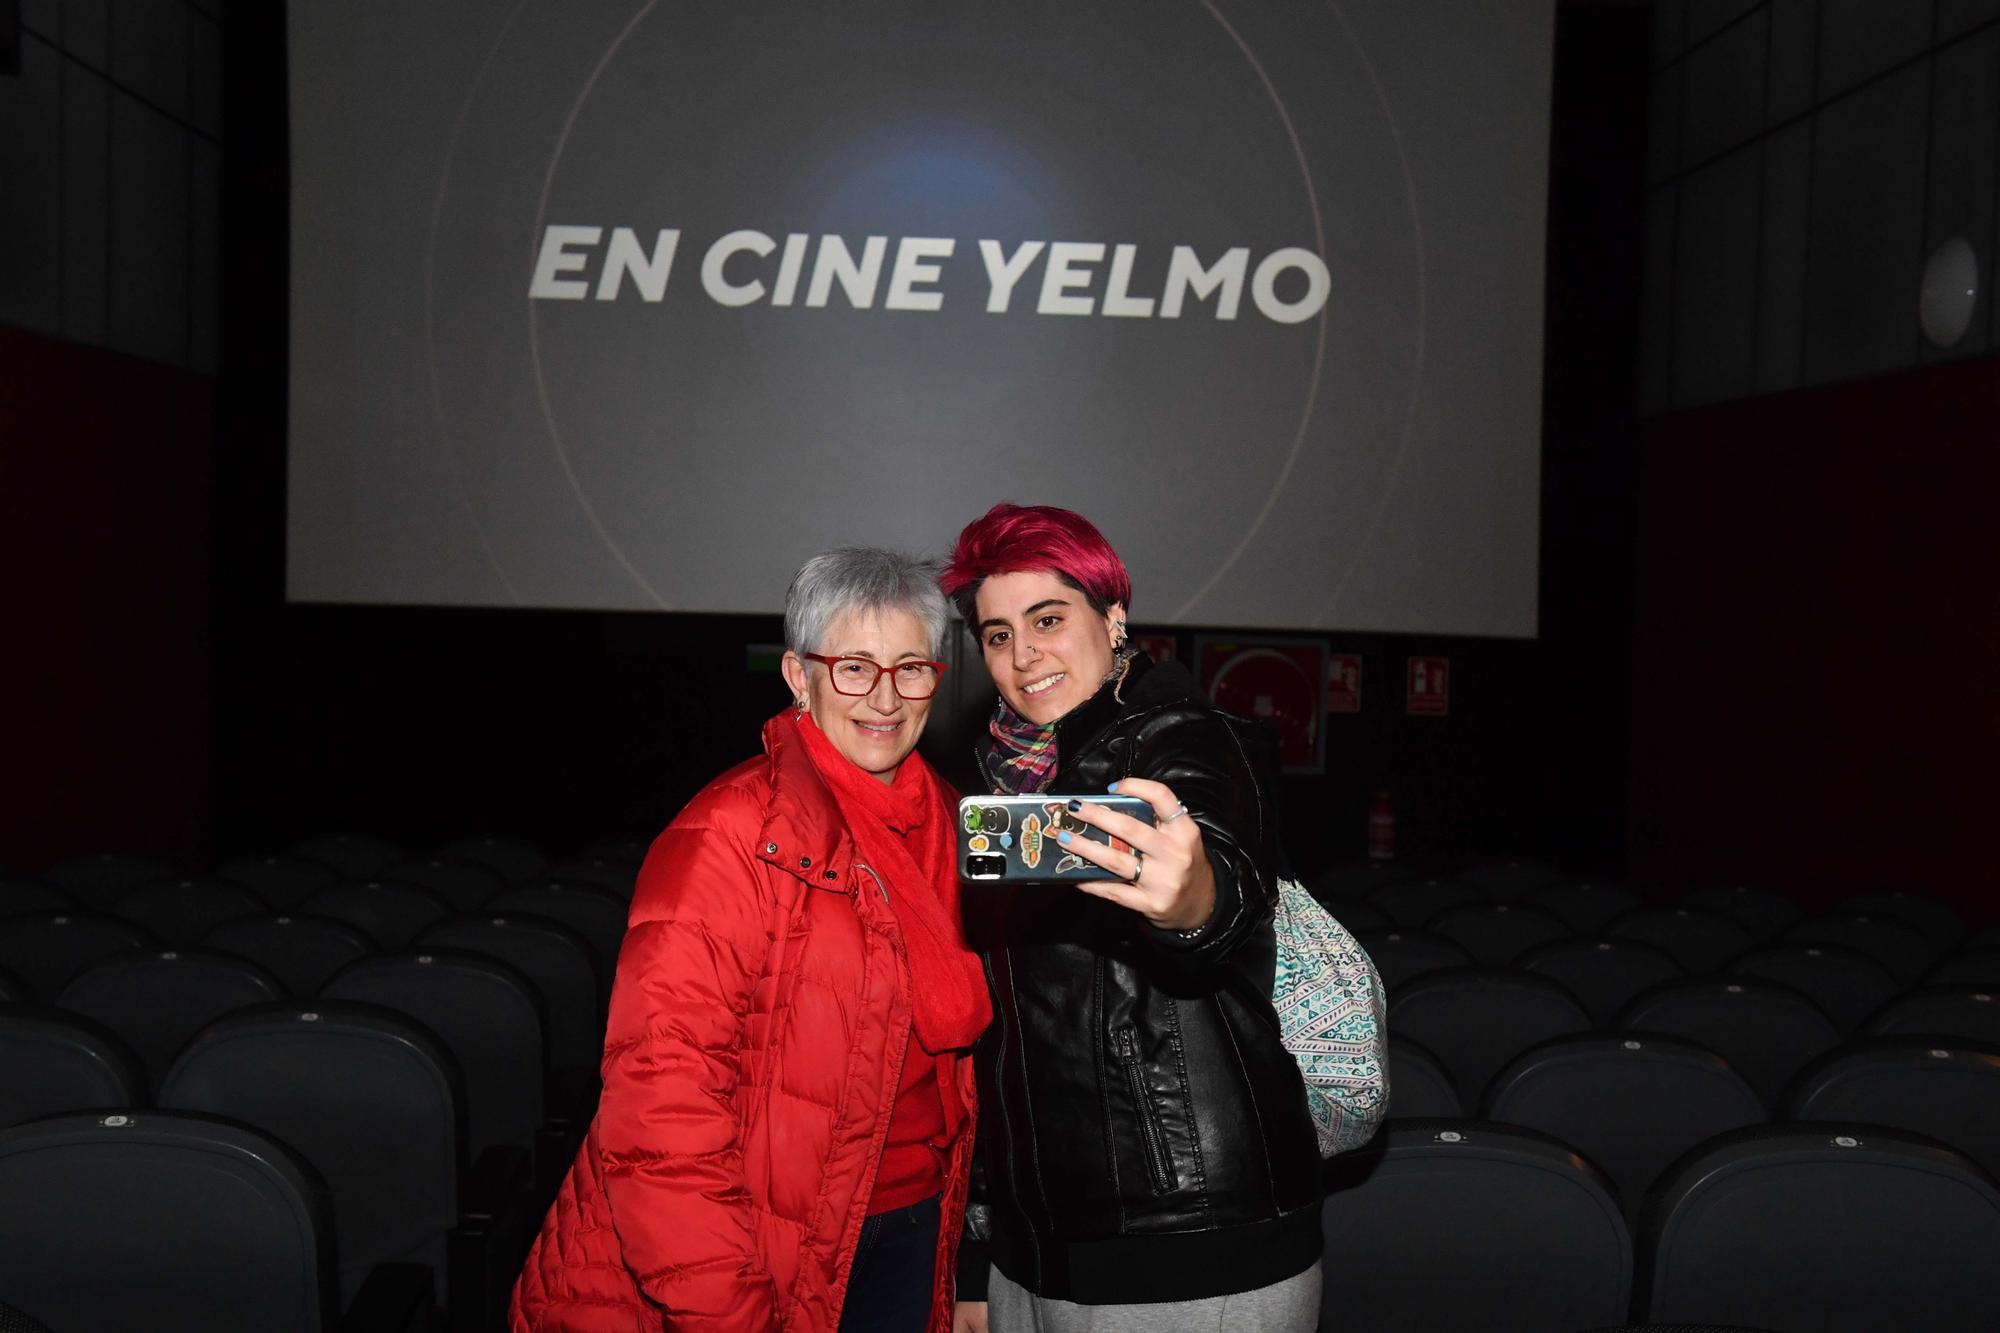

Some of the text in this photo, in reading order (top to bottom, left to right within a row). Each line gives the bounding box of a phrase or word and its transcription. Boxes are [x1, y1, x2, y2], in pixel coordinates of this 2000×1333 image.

[529, 226, 1331, 323] EN CINE YELMO
